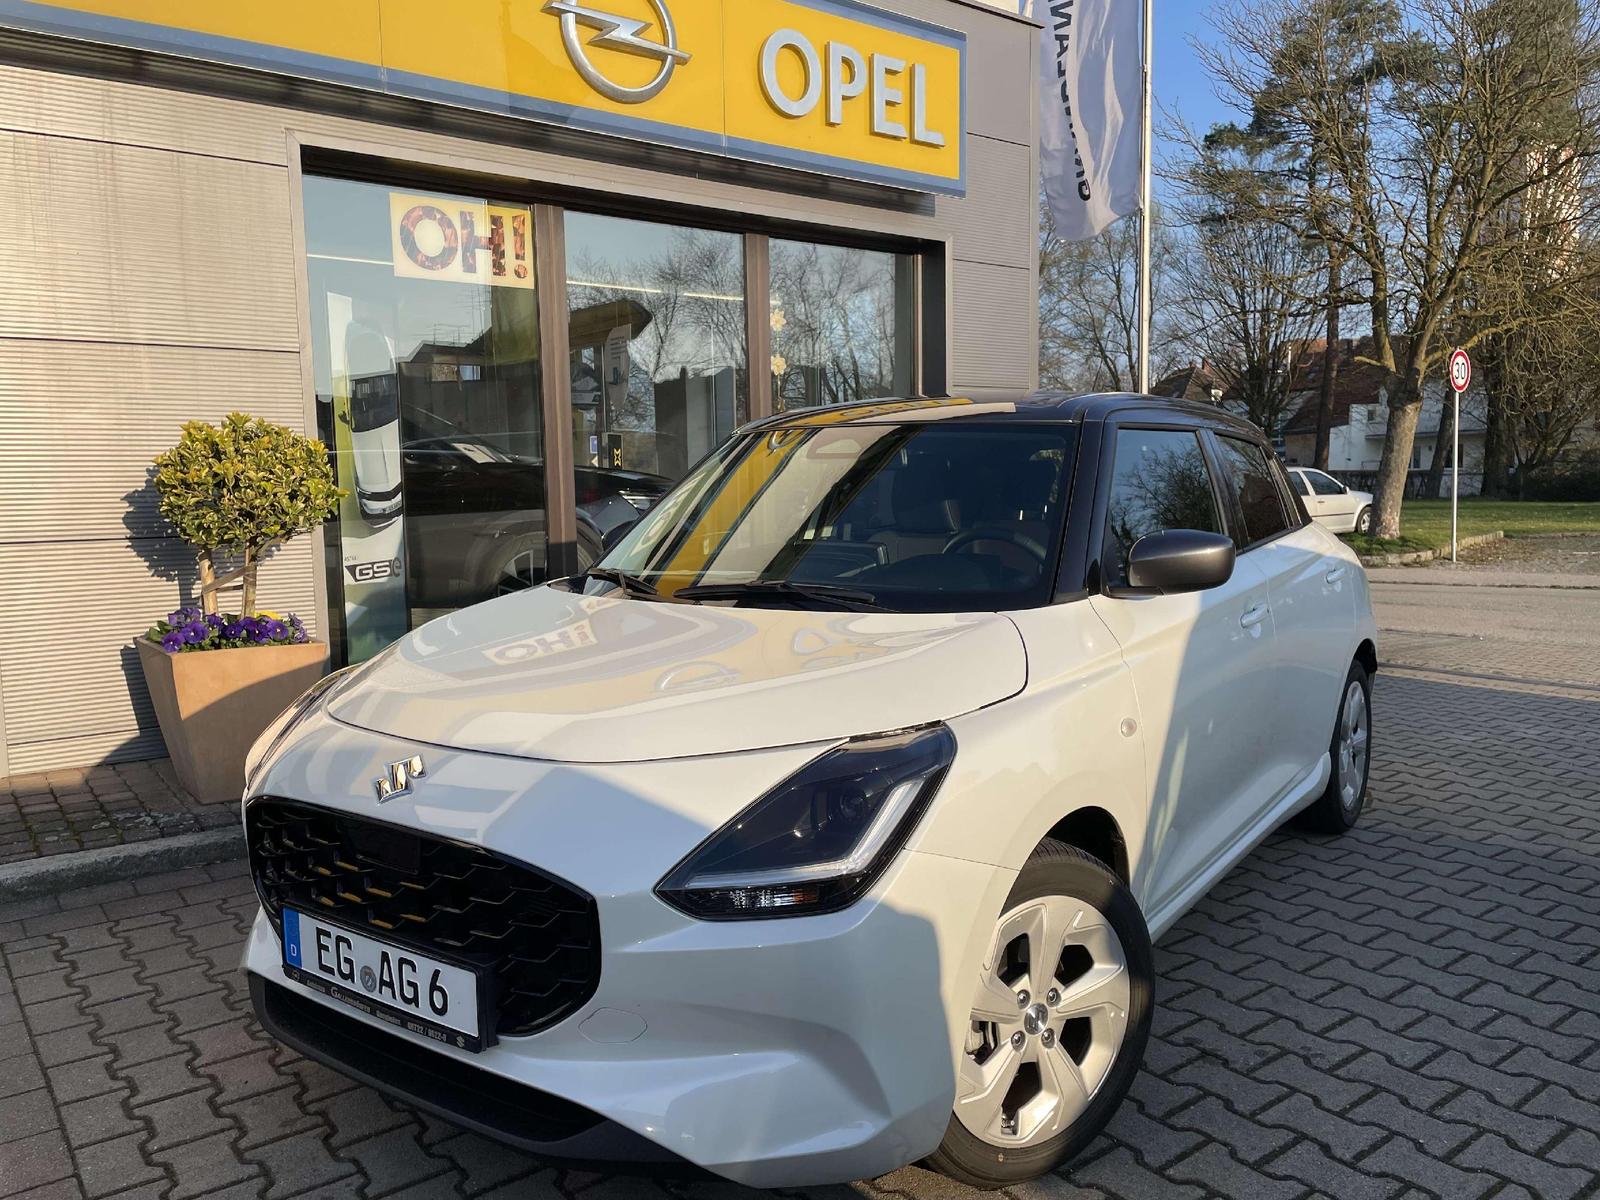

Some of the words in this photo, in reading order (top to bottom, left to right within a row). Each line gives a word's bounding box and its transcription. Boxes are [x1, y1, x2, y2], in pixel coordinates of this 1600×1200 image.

[758, 28, 946, 149] OPEL
[399, 205, 528, 279] OH!
[1454, 362, 1466, 380] 30
[355, 557, 401, 580] GSe
[290, 943, 298, 957] D
[316, 926, 356, 984] EG
[378, 950, 420, 1009] AG
[428, 968, 449, 1017] 6
